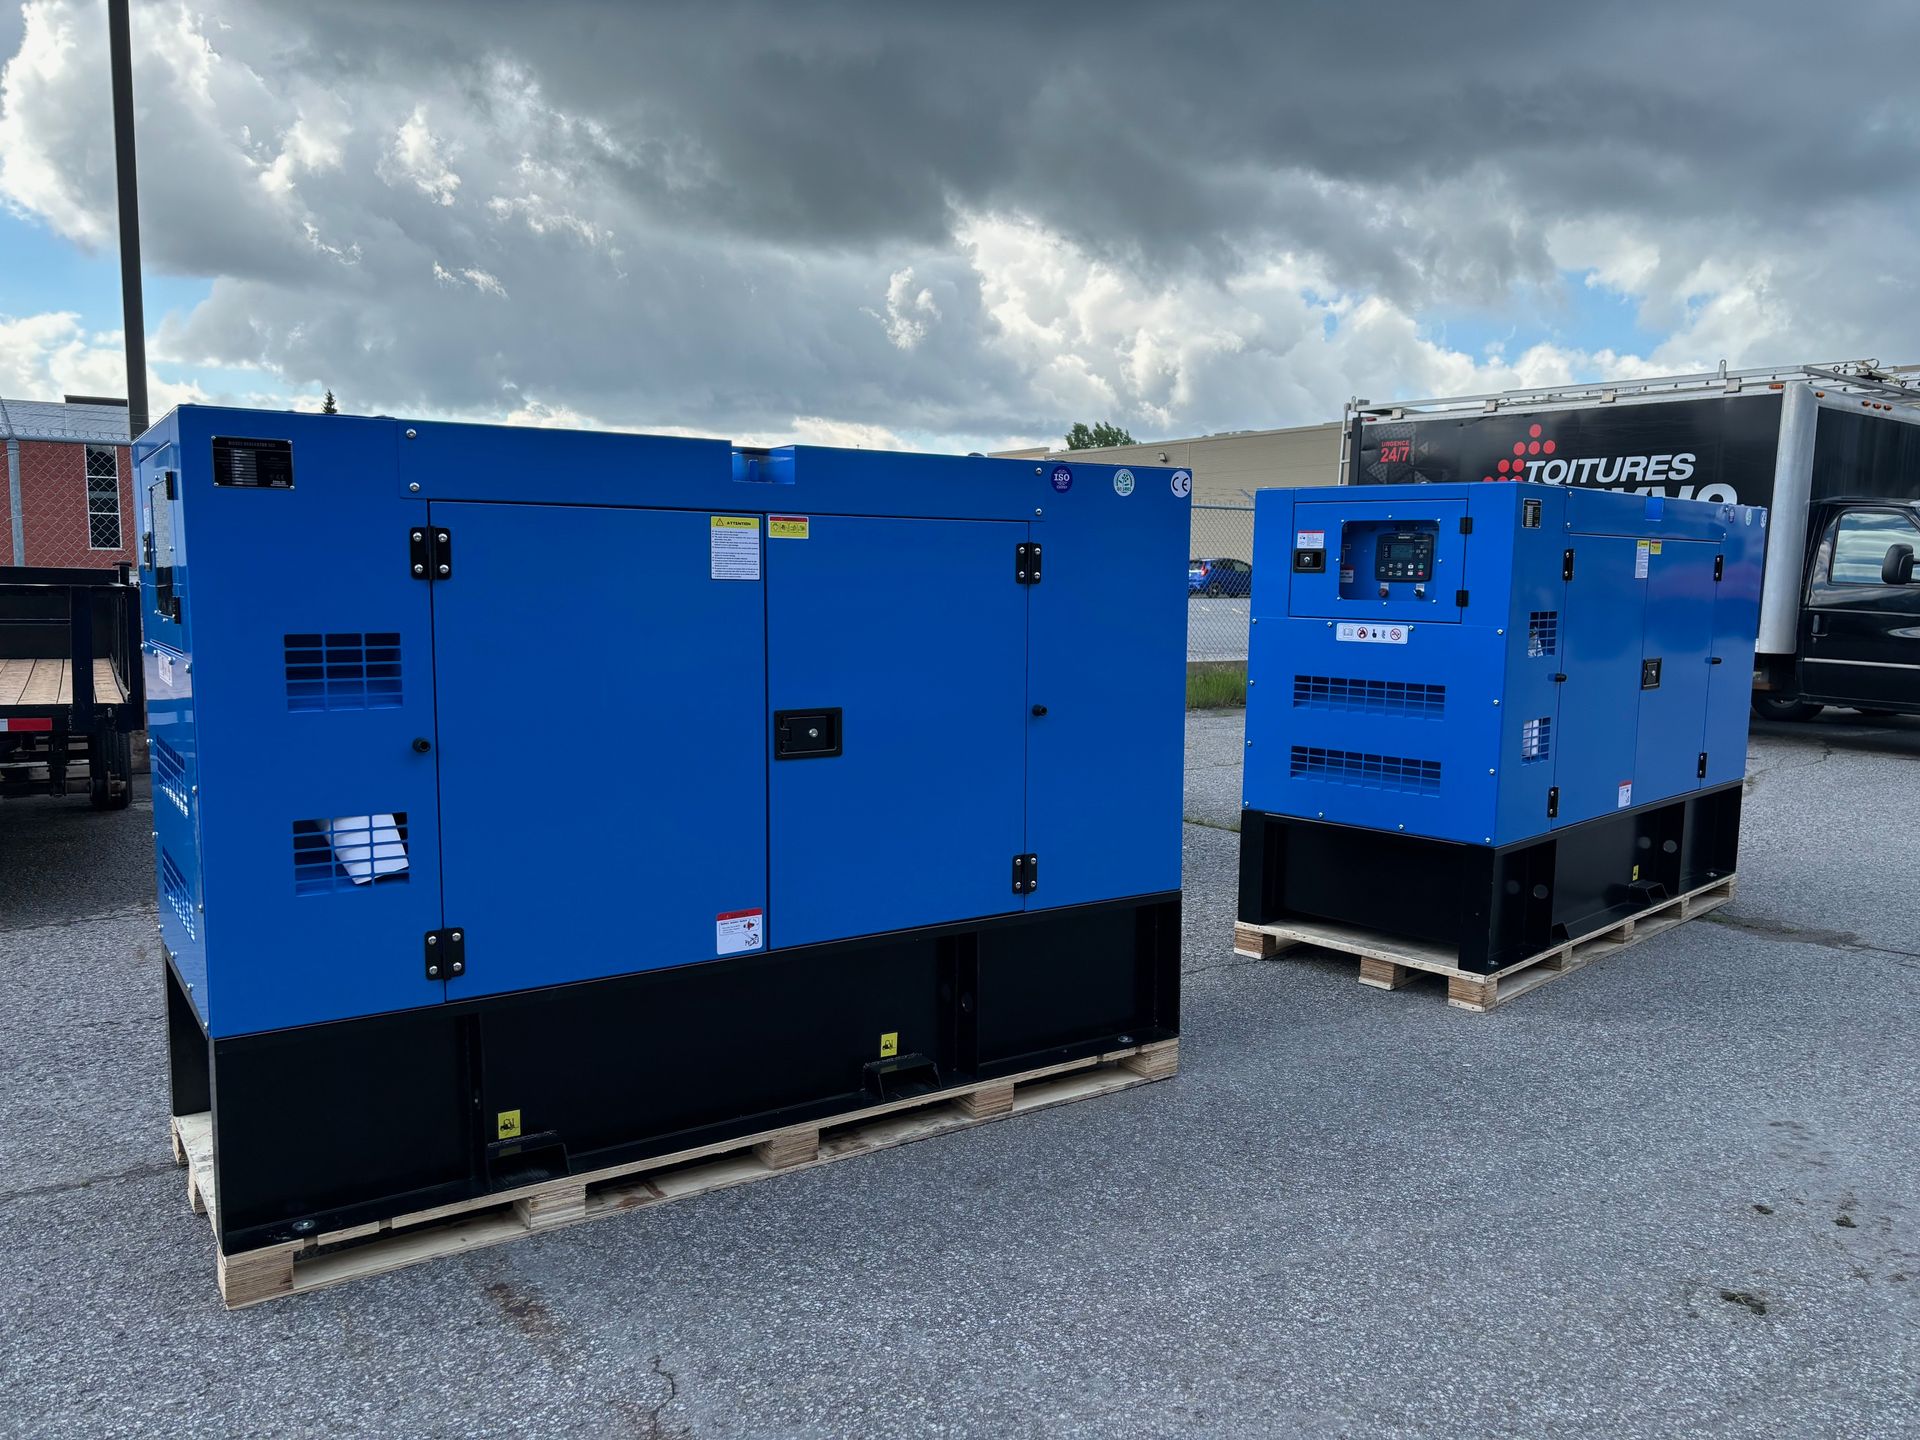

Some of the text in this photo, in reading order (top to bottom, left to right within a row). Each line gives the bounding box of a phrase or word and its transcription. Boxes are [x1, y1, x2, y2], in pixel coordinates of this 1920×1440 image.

[1380, 447, 1410, 463] 24/7
[1054, 473, 1070, 481] ISO
[1525, 453, 1696, 485] TOITURES
[1172, 476, 1189, 492] CE
